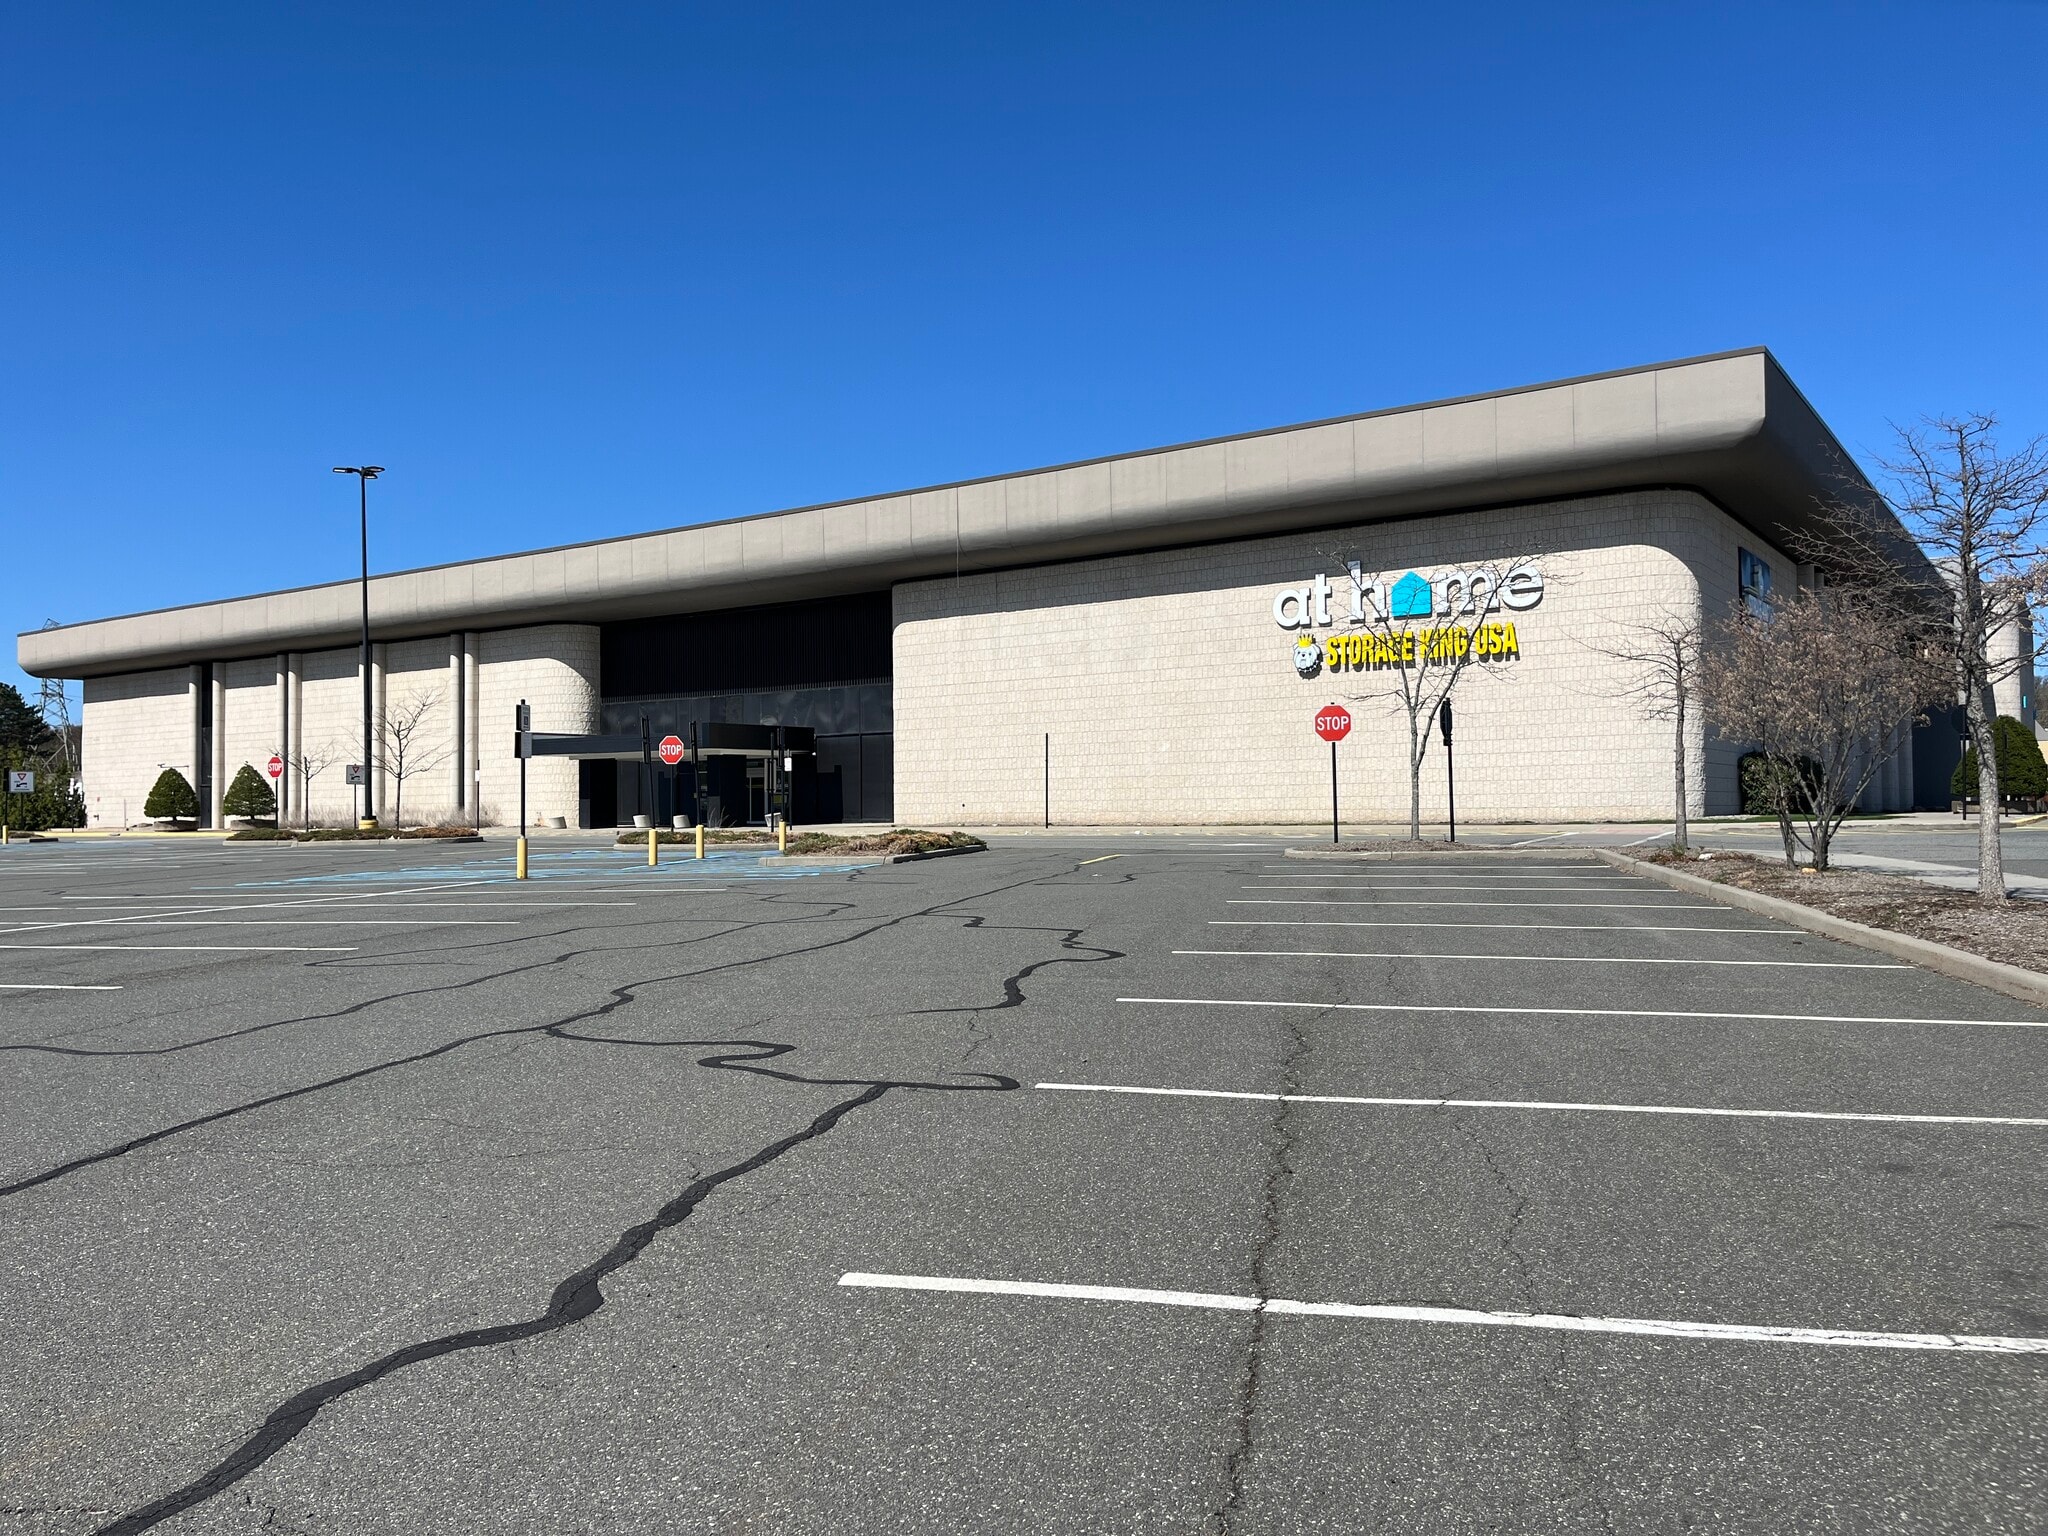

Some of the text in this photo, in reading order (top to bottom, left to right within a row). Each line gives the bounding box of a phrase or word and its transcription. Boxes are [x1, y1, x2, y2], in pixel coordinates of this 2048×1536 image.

[1273, 574, 1331, 628] at
[1326, 622, 1518, 666] STORAGE KING USA
[1317, 716, 1349, 731] STOP
[661, 744, 682, 756] STOP
[268, 762, 282, 772] STOP
